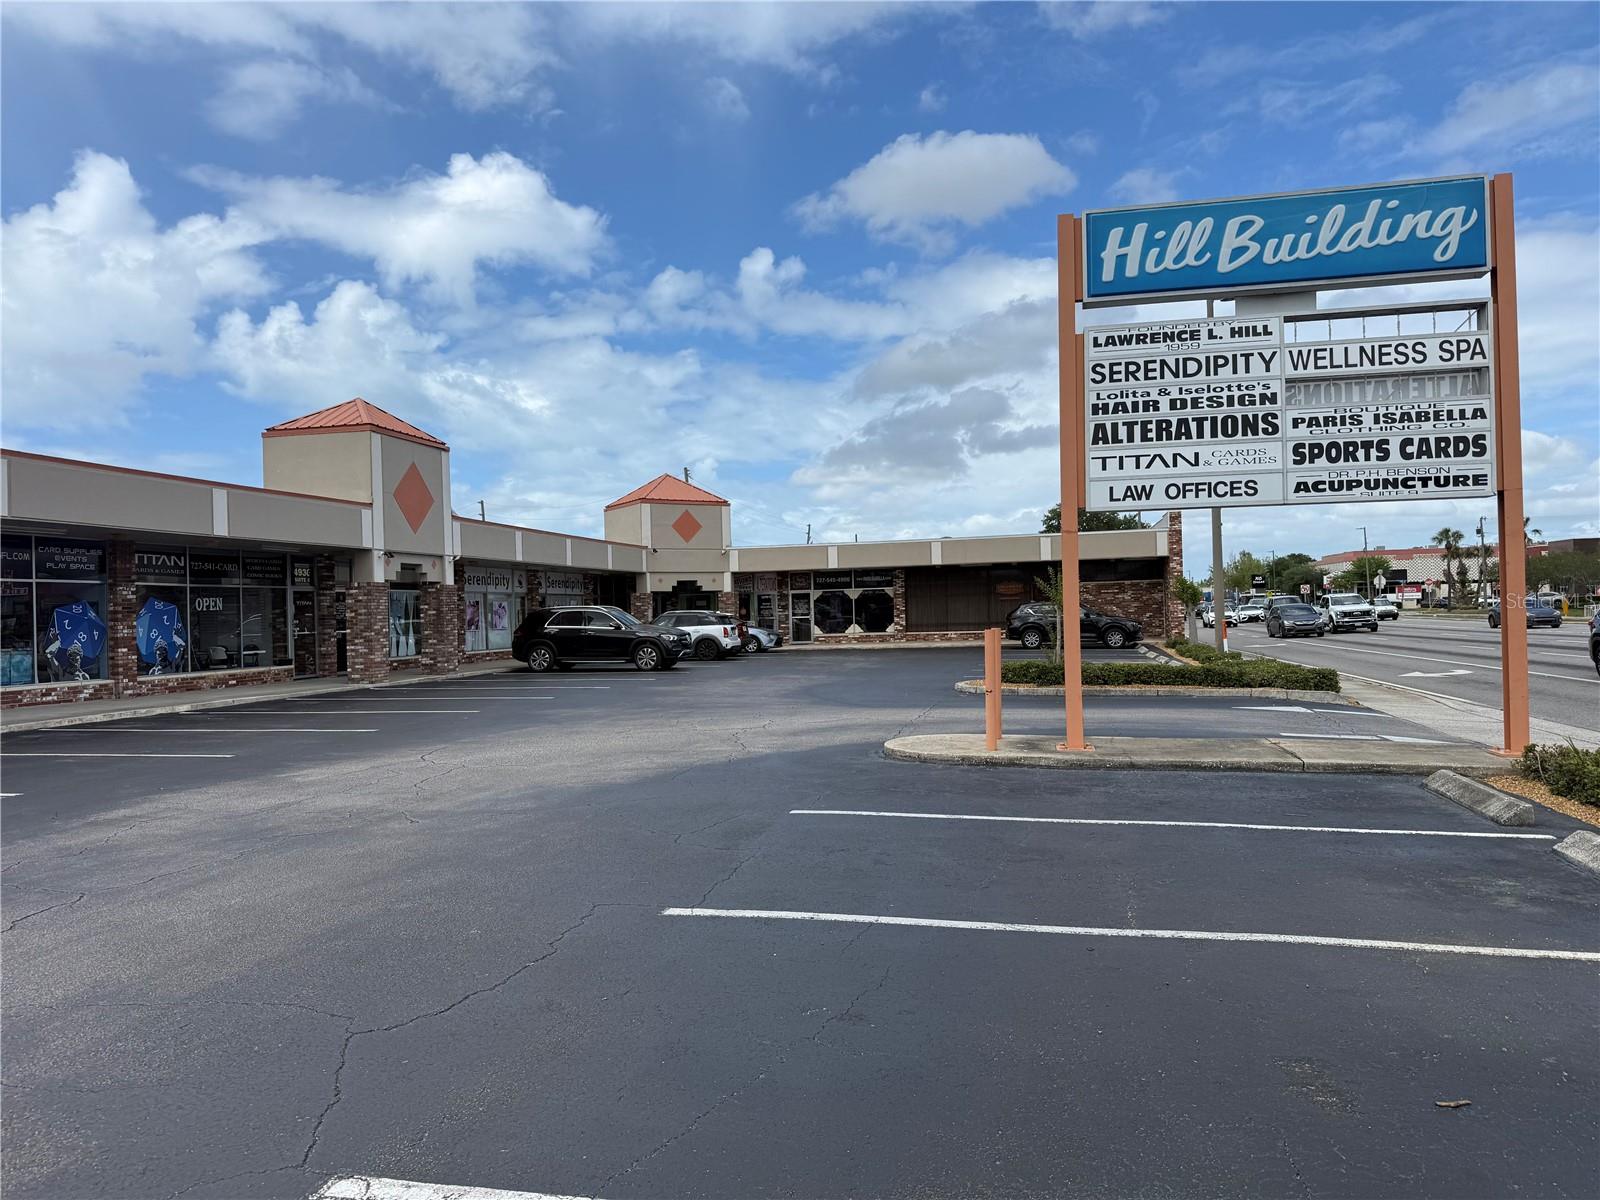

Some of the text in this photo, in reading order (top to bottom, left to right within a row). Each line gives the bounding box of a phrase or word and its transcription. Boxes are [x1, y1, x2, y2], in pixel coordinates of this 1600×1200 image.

[1100, 198, 1478, 282] Hill Building
[1093, 324, 1273, 348] LAWRENCE L. HILL
[1164, 342, 1201, 351] 1959
[1288, 338, 1487, 371] WELLNESS SPA
[1090, 351, 1278, 384] SERENDIPITY
[1096, 382, 1271, 401] Lolita & Iselotte's
[1091, 392, 1278, 416] HAIR DESIGN
[1334, 403, 1445, 414] BOUTIQUE
[1292, 407, 1487, 429] PARIS ISABELLA
[1091, 412, 1279, 446] ALTERATIONS
[1309, 424, 1422, 435] CLOTHING
[1211, 448, 1267, 458] CARDS
[1292, 434, 1487, 465] SPORTS CARDS
[1091, 452, 1199, 471] TITAN
[1218, 456, 1277, 466] GAMES
[1328, 466, 1451, 479] DR. P.H. BENSON
[1109, 479, 1259, 502] LAW OFFICES
[1293, 474, 1488, 493] ACUPUNCTURE
[546, 577, 584, 589] Serendipity
[195, 597, 223, 611] OPEN
